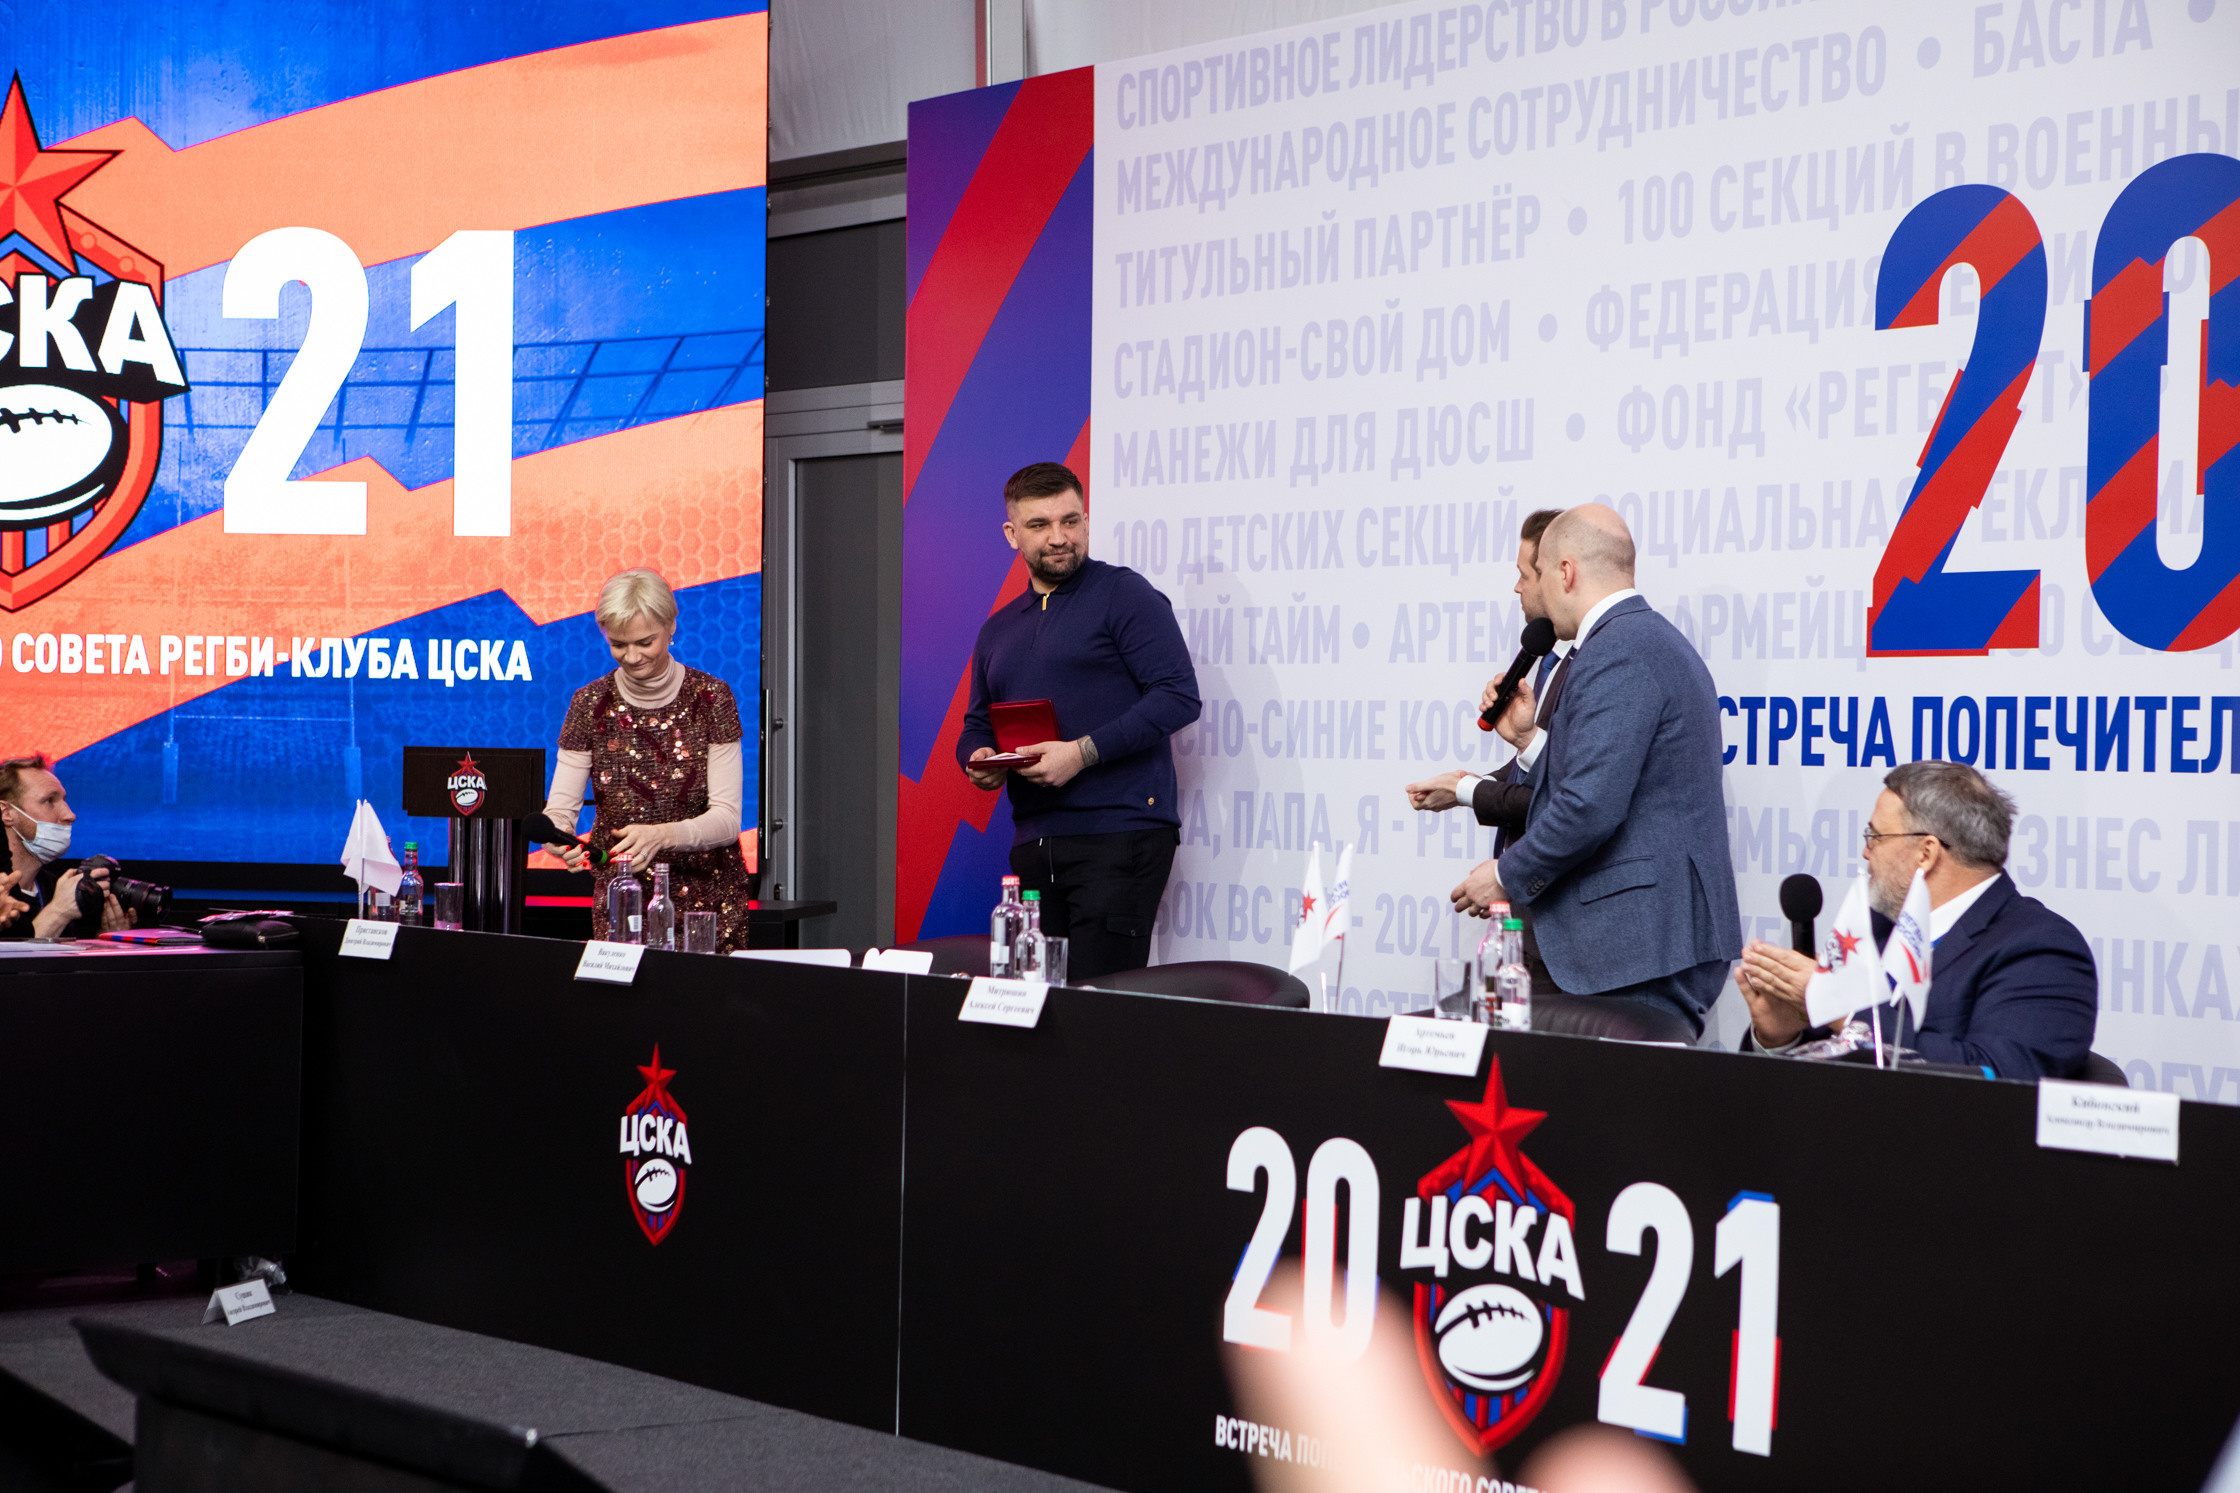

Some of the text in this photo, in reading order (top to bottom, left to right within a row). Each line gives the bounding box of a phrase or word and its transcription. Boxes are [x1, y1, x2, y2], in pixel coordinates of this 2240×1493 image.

[1116, 31, 1341, 131] СПОРТИВНОЕ
[1349, 0, 1589, 90] ЛИДЕРСТВО
[1972, 0, 2154, 79] БАСТА
[1116, 25, 1887, 216] МЕЖДУНАРОДНОЕ СОТРУДНИЧЕСТВО
[1618, 170, 1694, 245] 100
[1709, 121, 1915, 233] СЕКЦИЙ
[1934, 130, 1967, 194] В
[1115, 182, 1542, 309] ТИТУЛЬНЫЙ ПАРТНЁР
[222, 226, 515, 537] 21
[1114, 297, 1511, 404] СТАДИОН-СВОЙ ДОМ
[1113, 397, 1535, 488] МАНЕЖИ ДЛЯ ДЮСШ
[1617, 377, 1766, 459] ФОНД
[1866, 152, 2240, 657] 20
[1112, 485, 1518, 586] 100 ДЕТСКИХ СЕКЦИЙ
[12, 632, 533, 686] СОВЕТА РЕГБИ-КЛУБА ЦСКА
[1243, 592, 1341, 665] ТАЙМ
[1388, 600, 1520, 664] АРТЕМ
[447, 775, 488, 791] ЦСКА
[1356, 794, 1380, 855] Я
[1228, 883, 1273, 945] ВС
[1375, 893, 1460, 960] 2021
[619, 1113, 693, 1166] ЦСКА
[1222, 1126, 1781, 1458] 20 ЦСКА 21
[1215, 1413, 1293, 1462] ВСТРЕЧА
